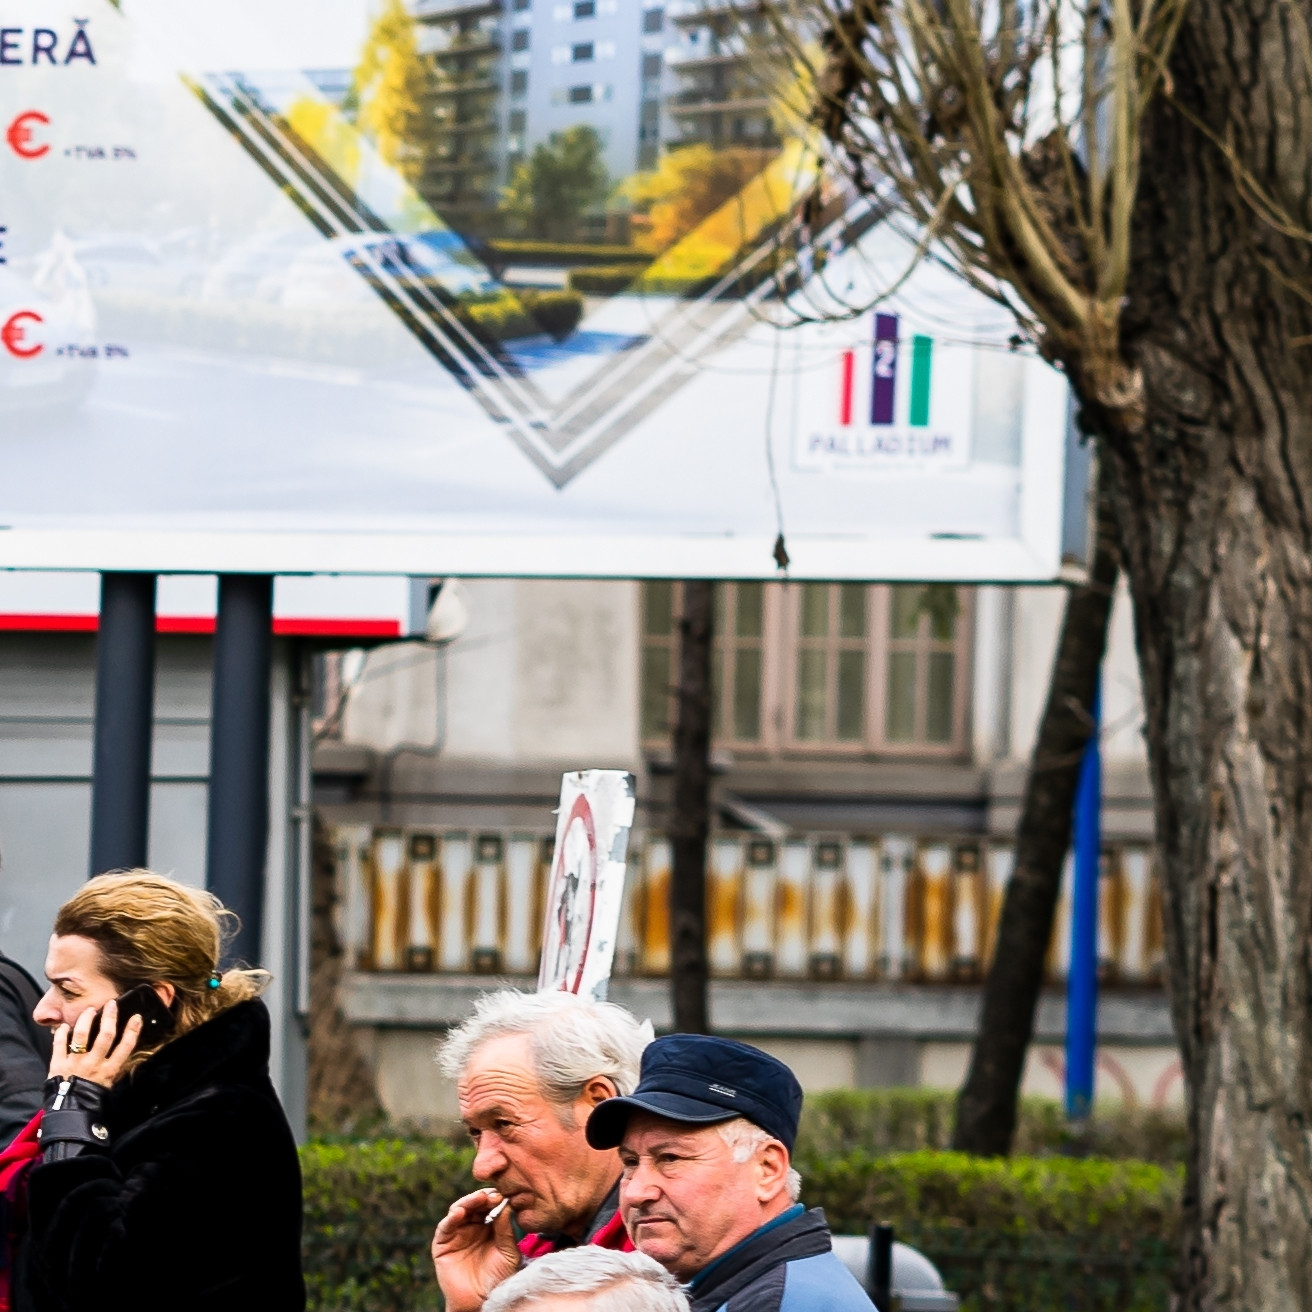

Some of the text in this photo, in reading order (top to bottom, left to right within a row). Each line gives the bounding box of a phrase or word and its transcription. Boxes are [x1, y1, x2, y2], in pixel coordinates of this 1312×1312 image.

[6, 109, 51, 160] €
[0, 310, 44, 359] €
[876, 340, 895, 378] 2
[809, 435, 951, 457] PALLADIUM
